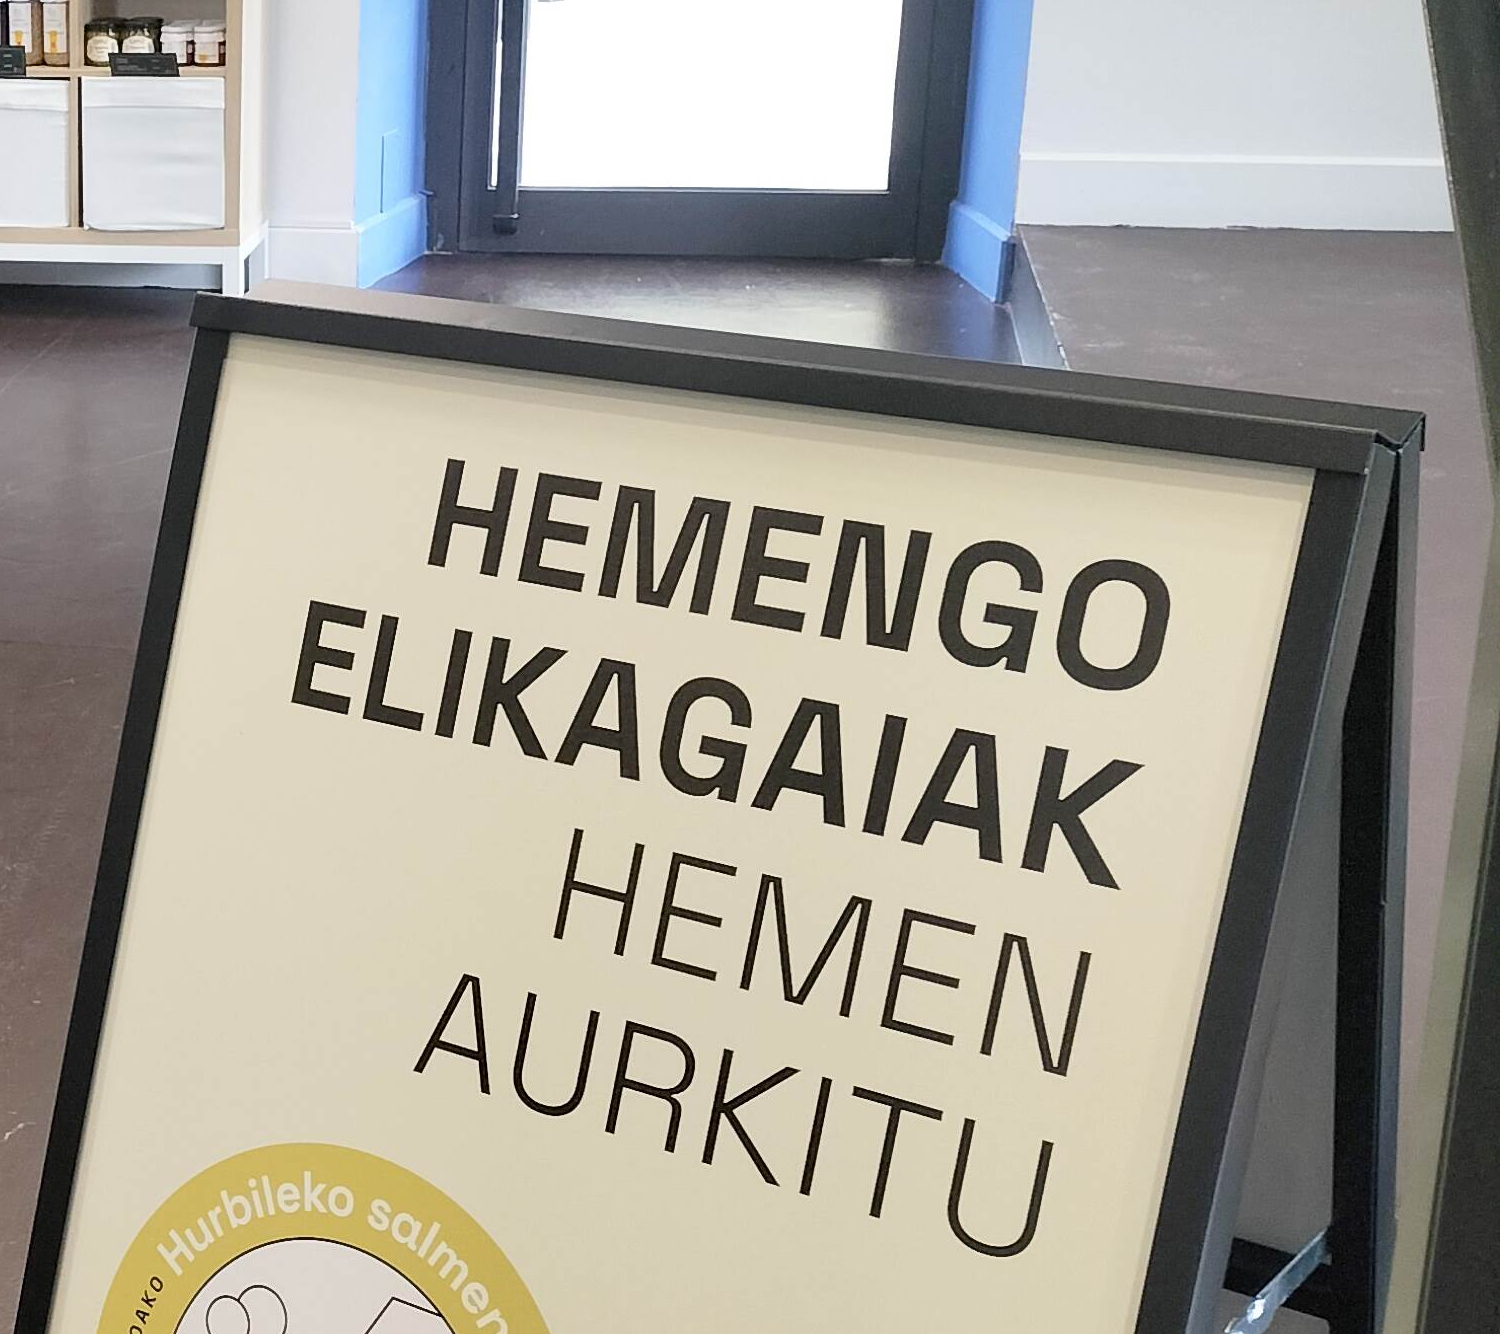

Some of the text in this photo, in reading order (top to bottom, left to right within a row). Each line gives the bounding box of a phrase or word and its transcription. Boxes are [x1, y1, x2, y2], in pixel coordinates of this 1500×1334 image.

[426, 457, 1172, 692] HEMENGO
[291, 599, 1146, 891] ELIKAGAIAK
[553, 827, 1093, 1078] HEMEN
[156, 1170, 355, 1277] Hurbileko
[412, 973, 1055, 1258] AURKITU
